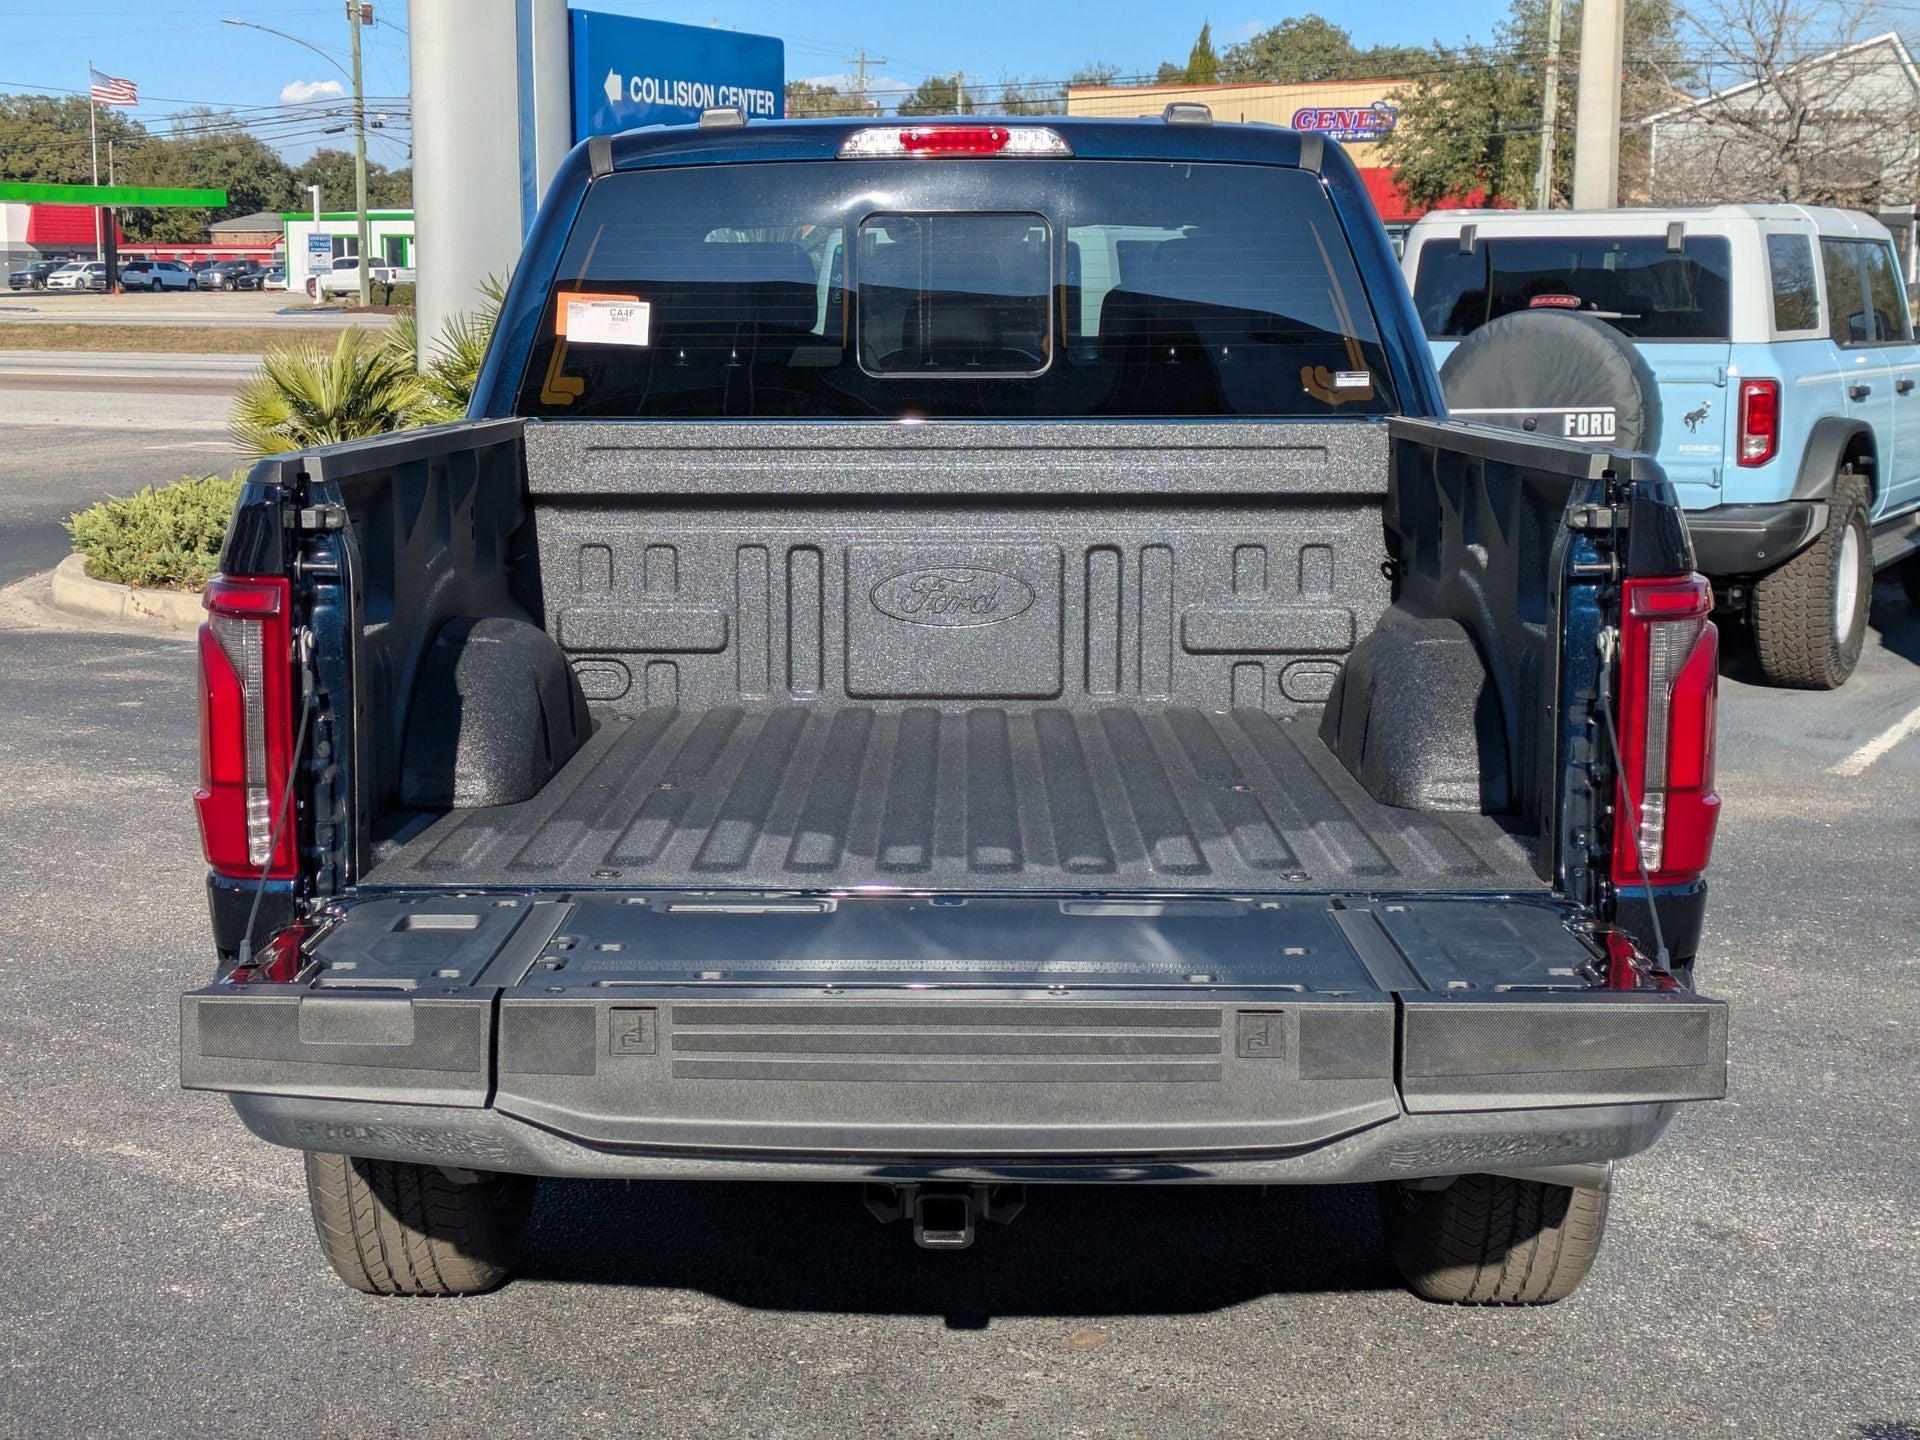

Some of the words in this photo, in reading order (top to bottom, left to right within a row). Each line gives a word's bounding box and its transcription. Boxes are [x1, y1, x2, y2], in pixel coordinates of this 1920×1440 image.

[630, 76, 713, 108] COLLISION
[719, 86, 775, 115] CENTER
[609, 308, 635, 317] CA4F
[1564, 413, 1616, 436] FORD
[900, 575, 1002, 614] Ford
